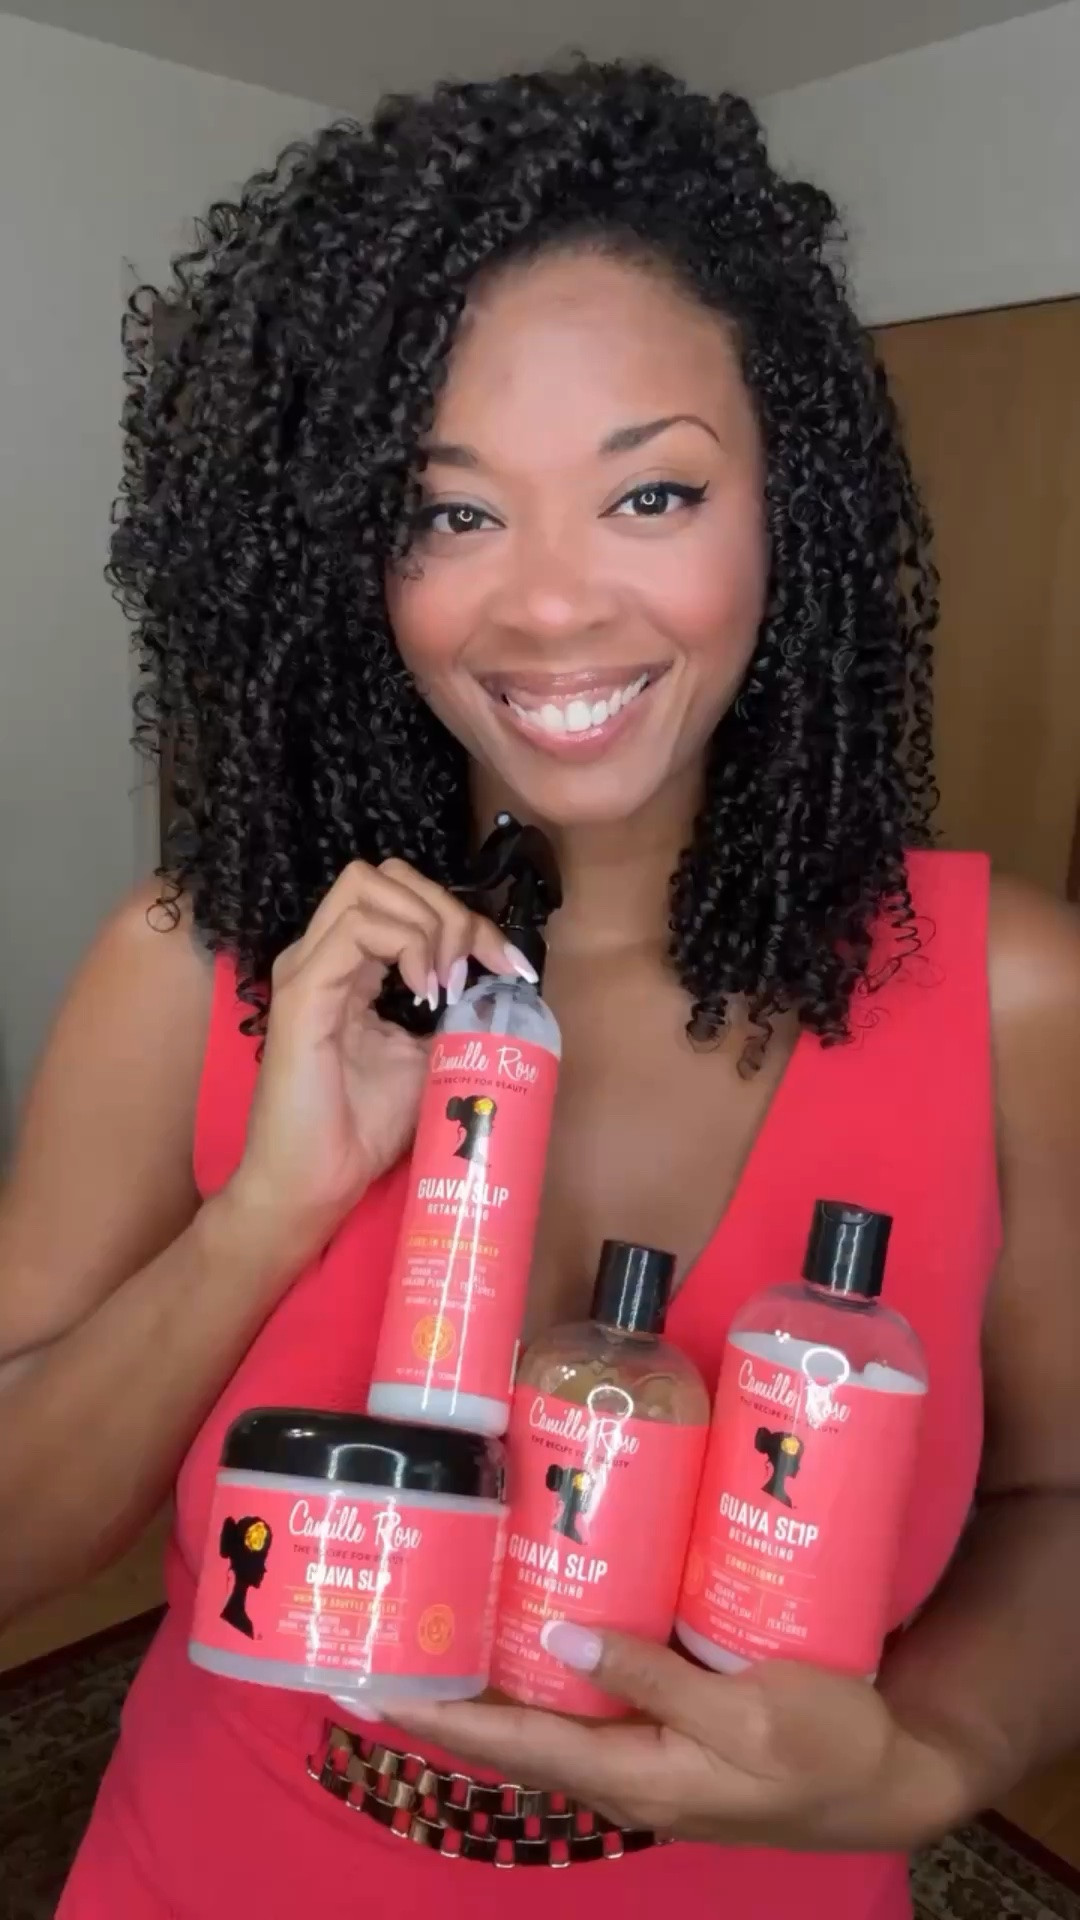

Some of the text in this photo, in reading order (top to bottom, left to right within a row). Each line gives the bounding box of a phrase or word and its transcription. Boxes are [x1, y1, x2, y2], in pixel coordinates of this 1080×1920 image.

[432, 1041, 539, 1084] Camille Rose
[496, 1080, 528, 1095] BEAUTY
[417, 1177, 509, 1208] GUAVA SLIP
[737, 1359, 850, 1423] Camille ose
[529, 1396, 640, 1456] Camille Rse
[545, 1440, 573, 1454] RECIPE
[289, 1499, 423, 1551] Camille Rose
[719, 1491, 819, 1549] GUAVA SLIP
[293, 1544, 311, 1555] THE
[350, 1551, 371, 1562] FOR
[508, 1533, 608, 1585] GUAVA SLIP
[725, 1553, 785, 1587] CONDITIONER
[357, 1568, 392, 1592] SLP
[518, 1566, 584, 1600] DETANGLING
